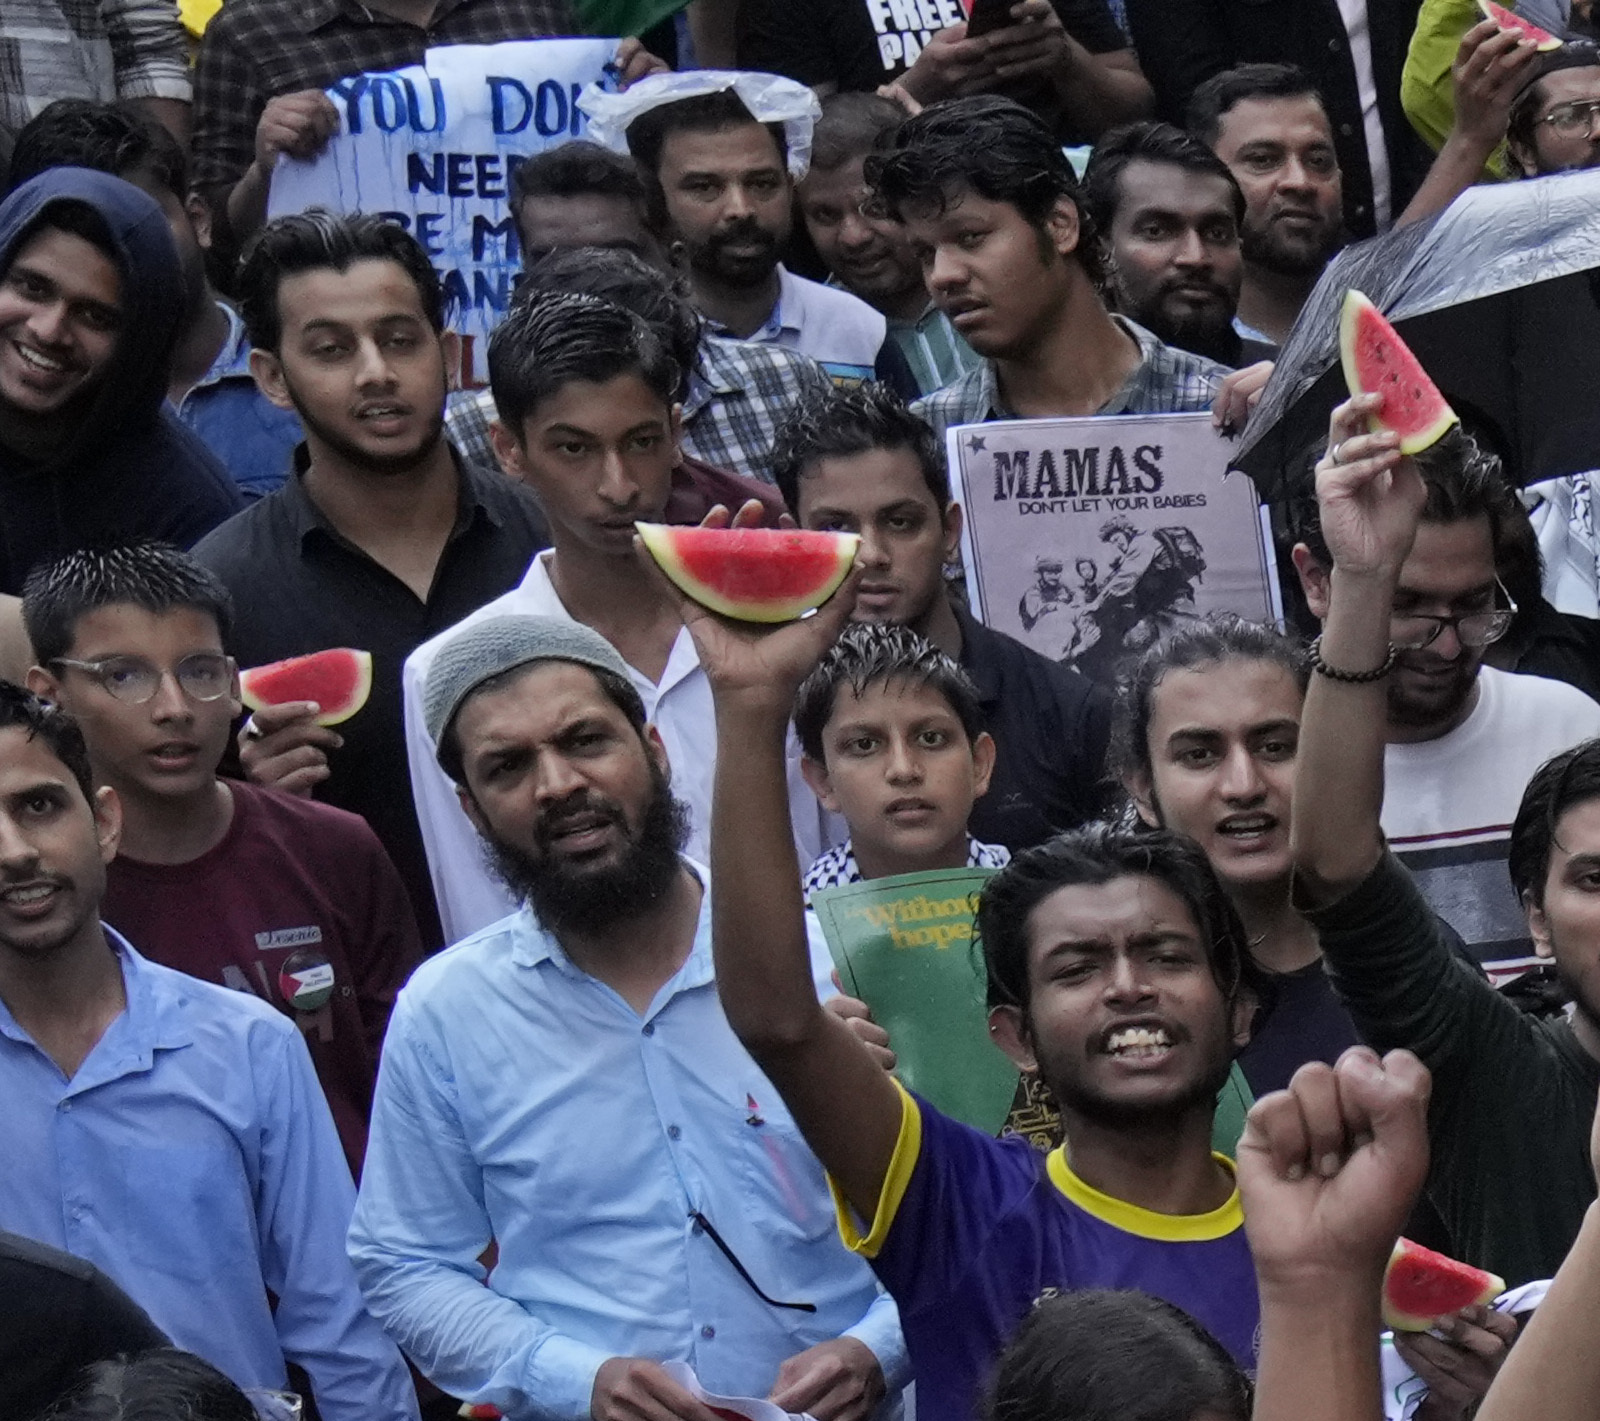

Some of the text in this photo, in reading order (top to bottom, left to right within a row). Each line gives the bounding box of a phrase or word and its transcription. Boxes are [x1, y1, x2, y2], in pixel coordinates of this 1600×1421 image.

[332, 76, 447, 134] YOU
[992, 444, 1165, 502] MAMAS
[1019, 493, 1208, 516] DON'T LET YOUR BABIES
